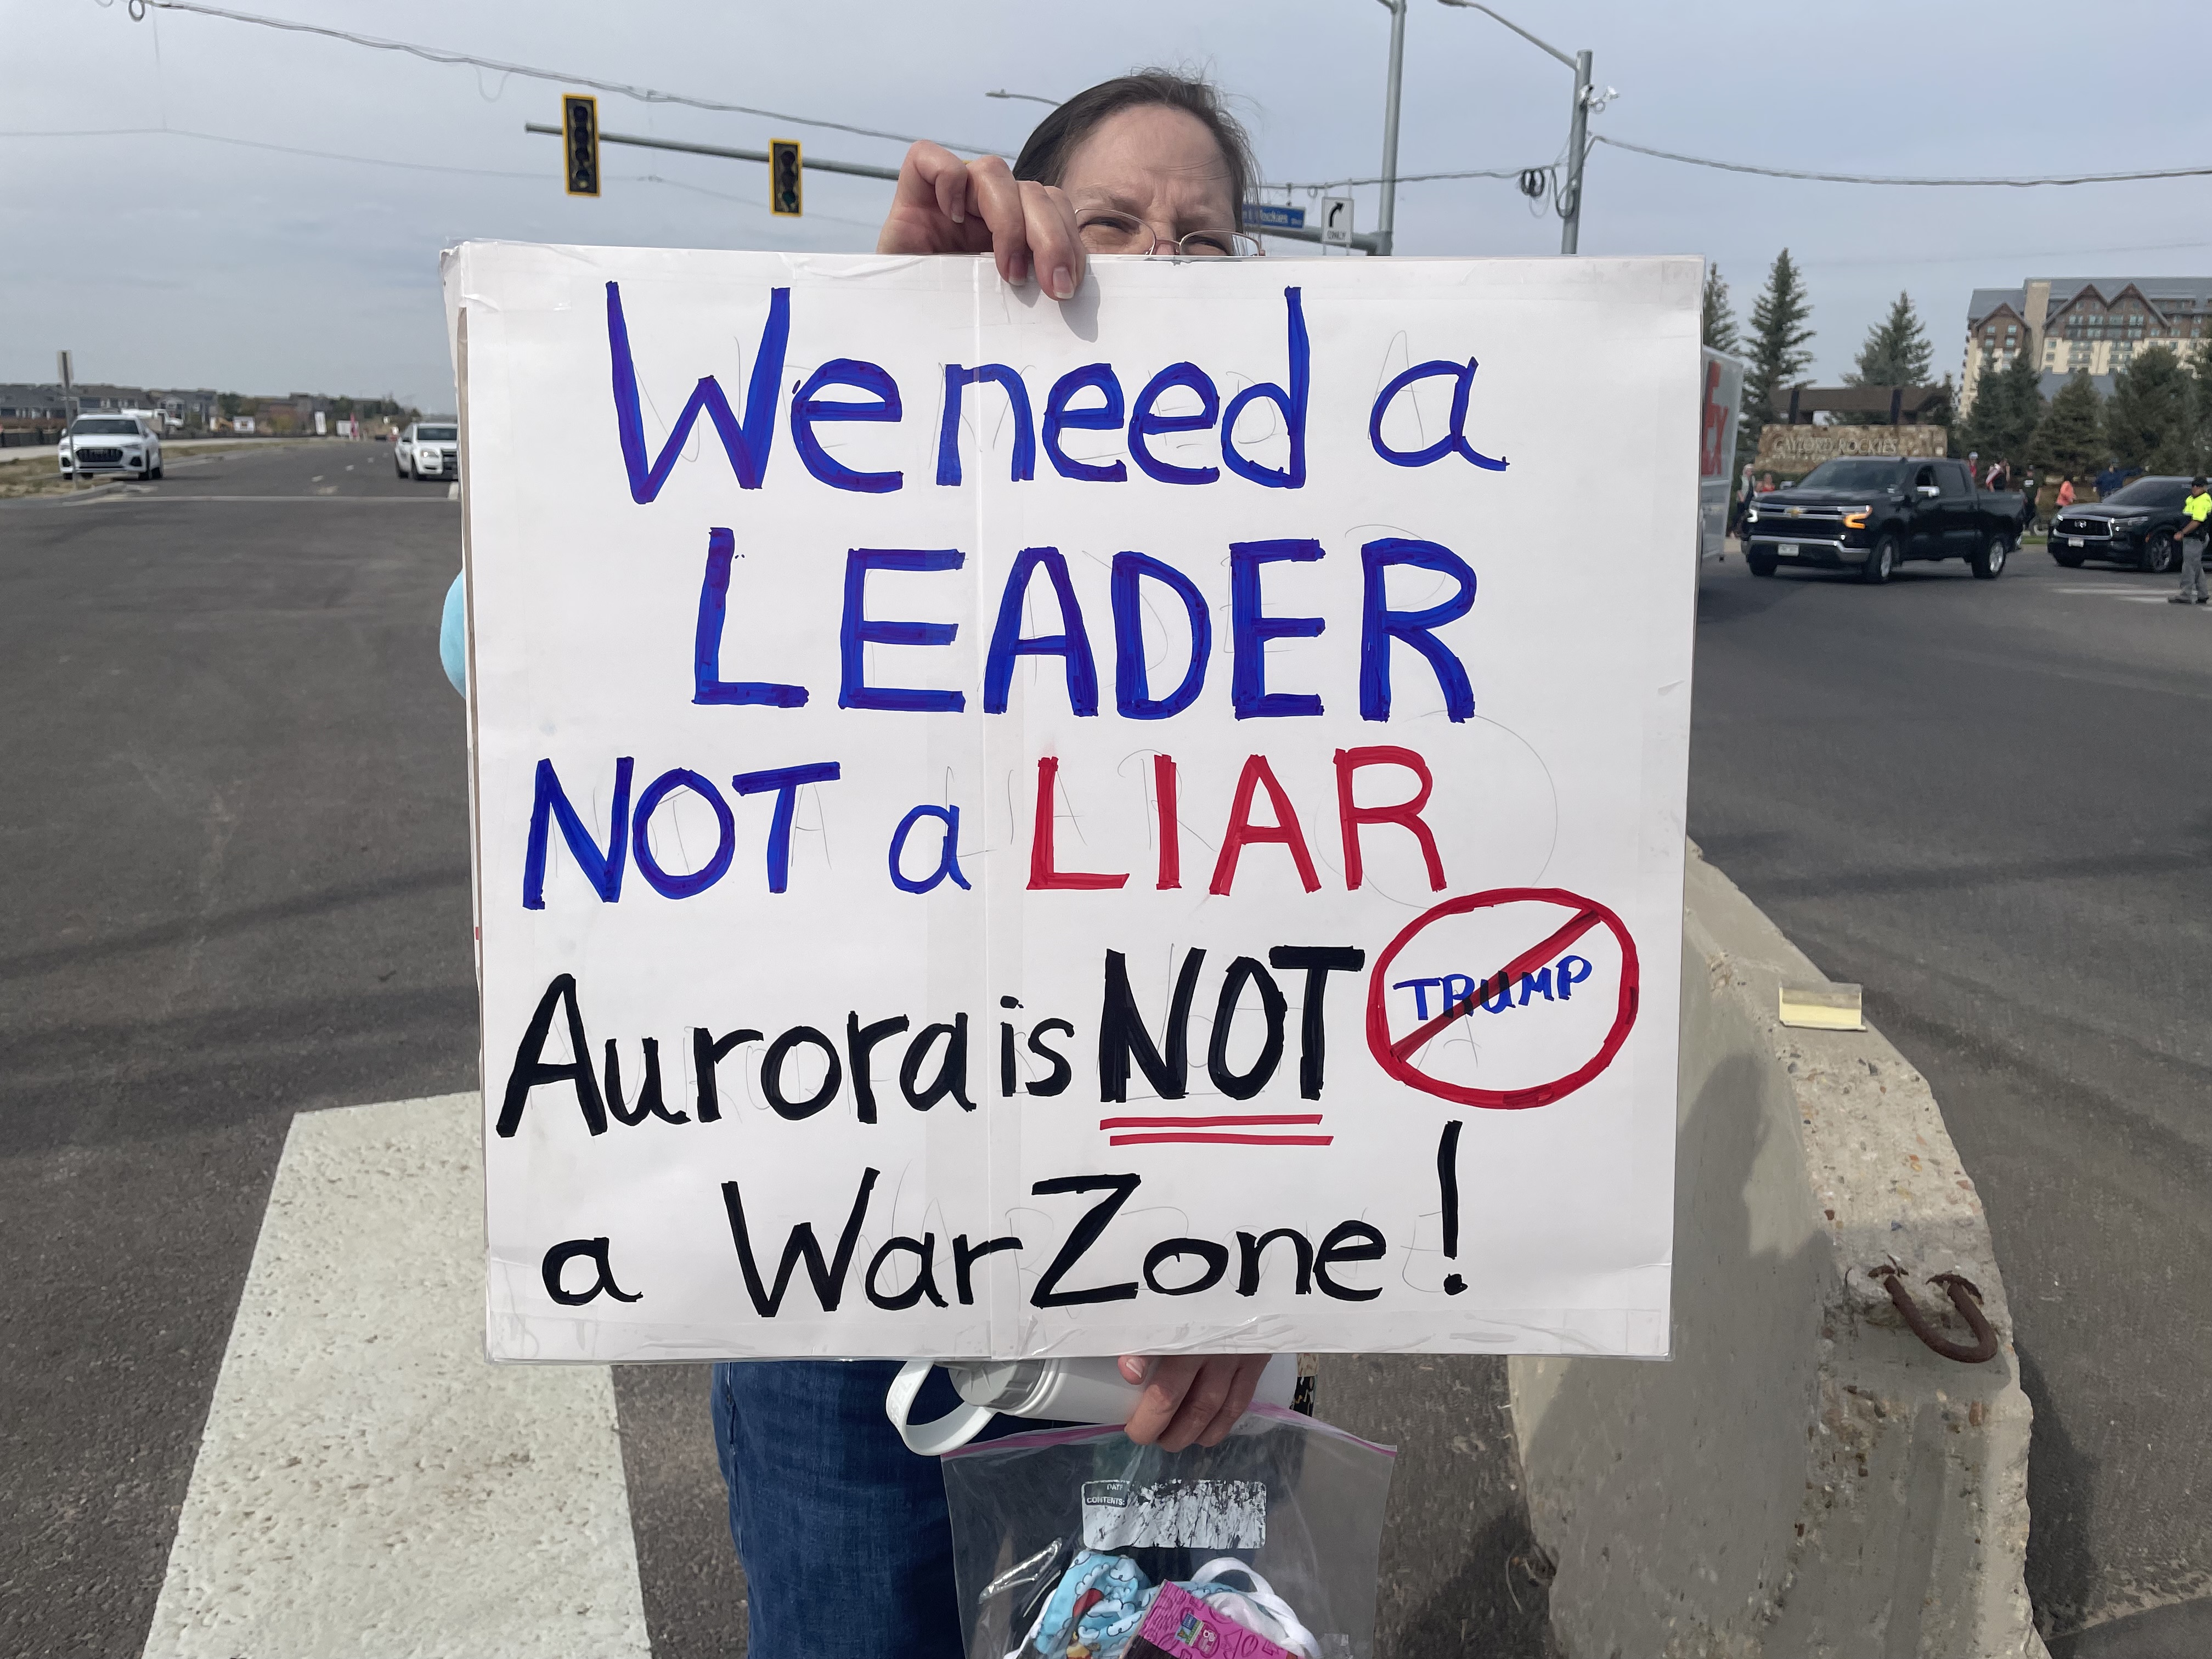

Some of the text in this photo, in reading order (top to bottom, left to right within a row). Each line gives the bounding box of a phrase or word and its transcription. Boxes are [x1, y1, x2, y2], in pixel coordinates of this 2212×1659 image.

[606, 281, 1510, 504] We need a
[691, 527, 1476, 724] LEADER
[523, 746, 1447, 910] NOT a LIAR
[496, 945, 1365, 1138] Aurora is NOT
[1393, 955, 1592, 1020] TRUMP
[542, 1237, 643, 1306] a
[1086, 1497, 1125, 1505] CONTENTS:
